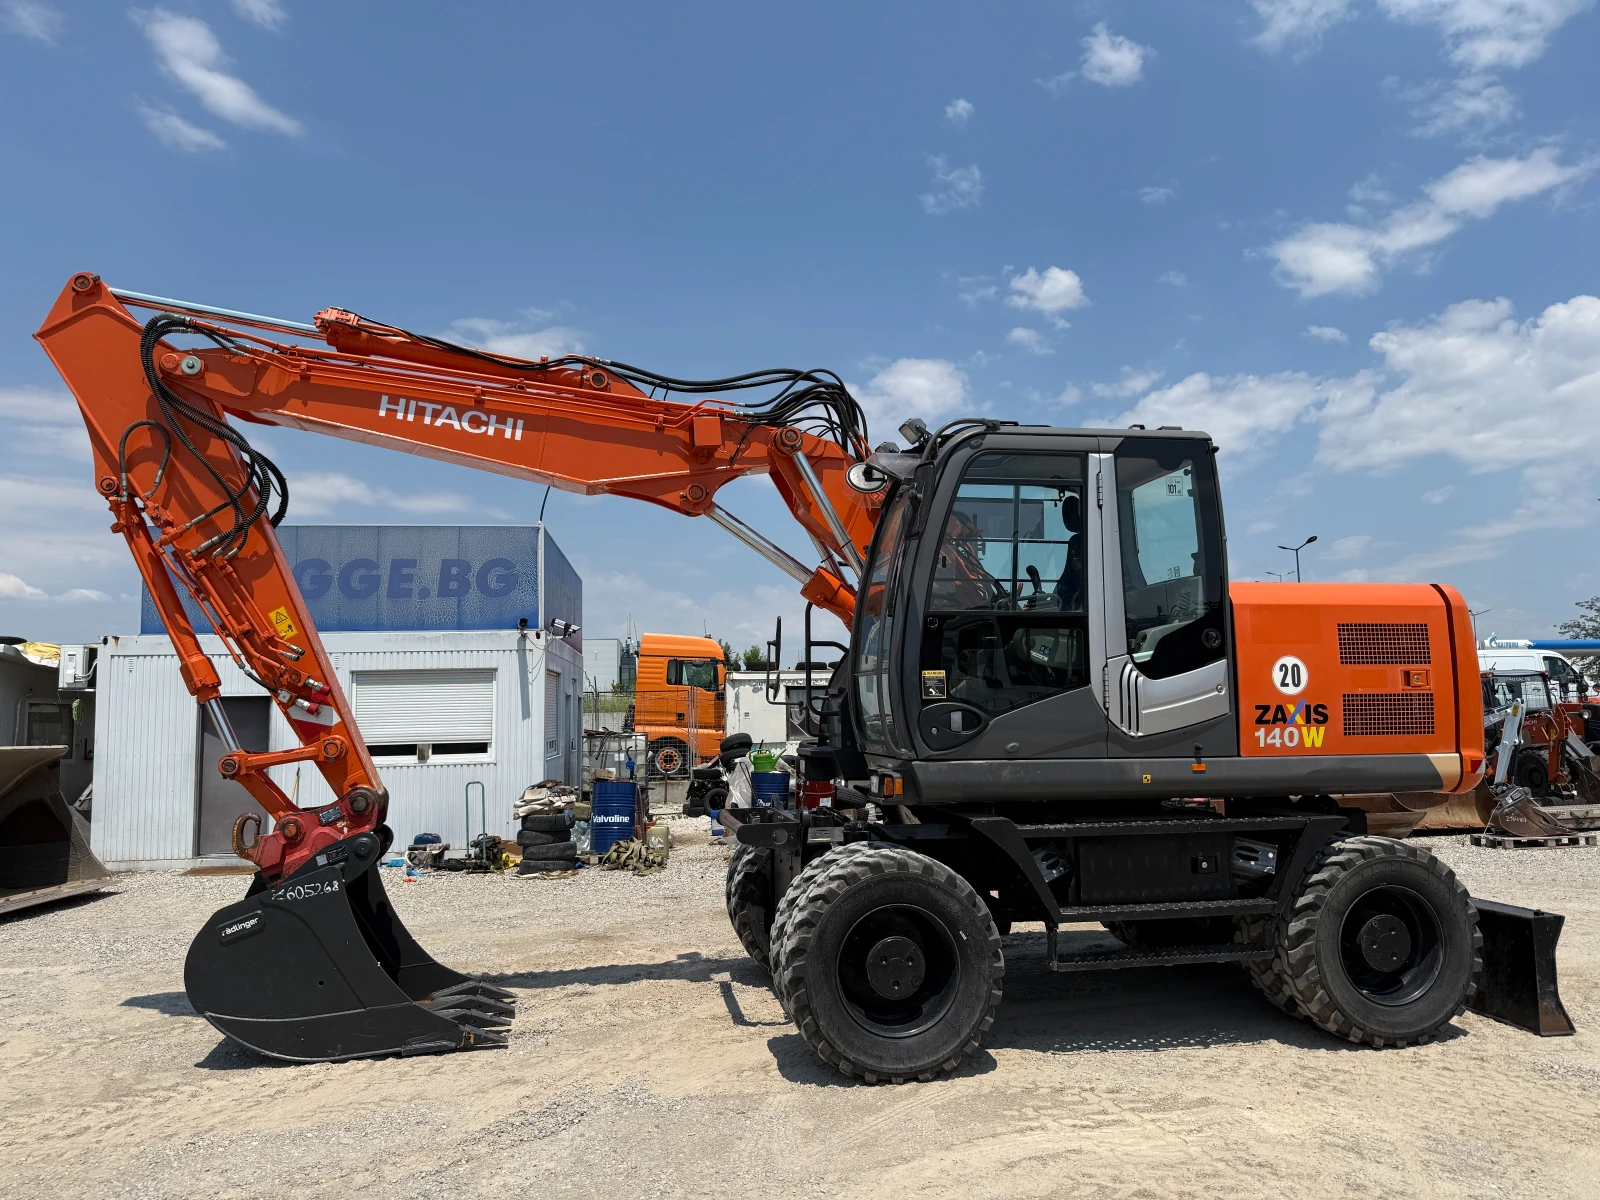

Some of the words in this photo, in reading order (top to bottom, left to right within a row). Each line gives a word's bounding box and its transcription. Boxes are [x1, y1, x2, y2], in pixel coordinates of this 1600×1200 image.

[378, 394, 524, 441] HITACHI
[1167, 484, 1177, 494] 101
[1279, 663, 1301, 687] 20
[1254, 699, 1329, 725] ZAXIS
[1254, 726, 1326, 748] 140W
[592, 814, 630, 823] Valvoline
